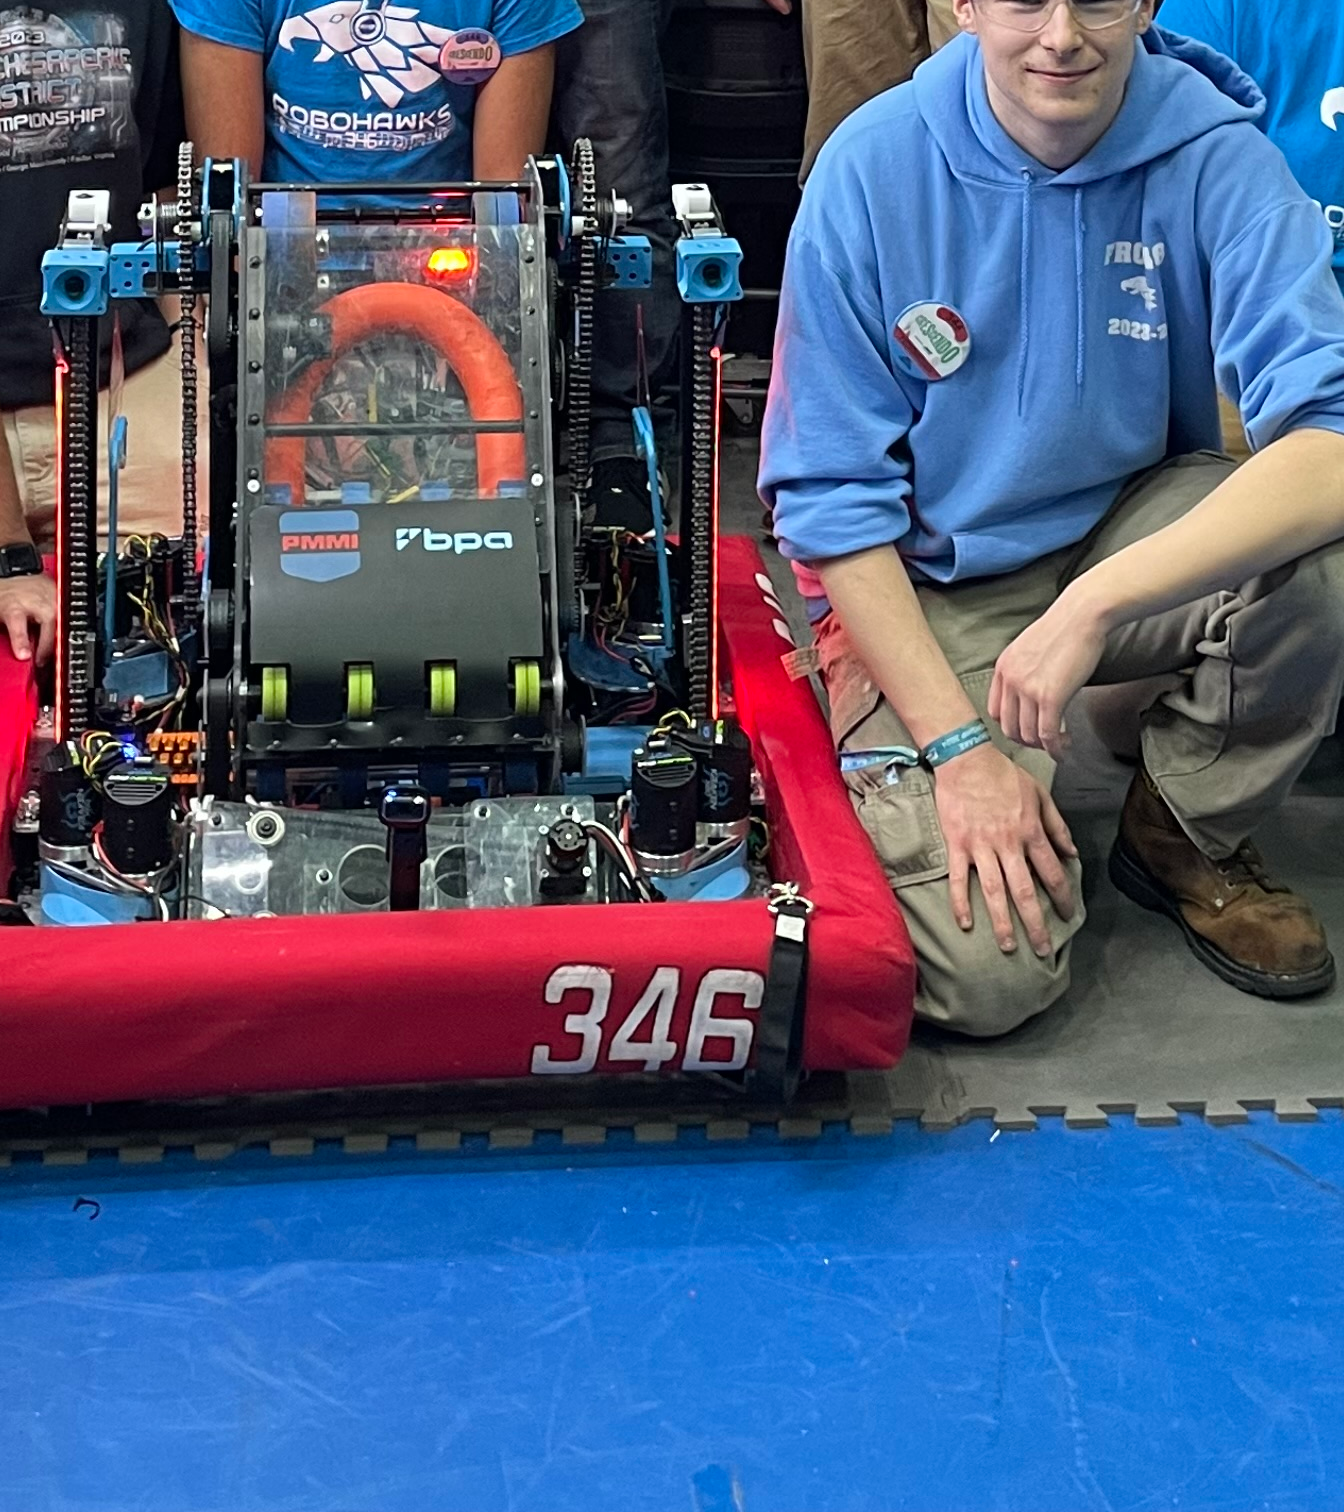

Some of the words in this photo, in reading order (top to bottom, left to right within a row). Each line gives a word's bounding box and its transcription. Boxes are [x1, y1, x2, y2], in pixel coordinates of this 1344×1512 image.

[272, 92, 451, 131] ROBOHAWKS
[346, 131, 378, 149] 346
[281, 534, 359, 551] PMMI
[423, 527, 513, 554] bpa
[531, 965, 765, 1074] 346
